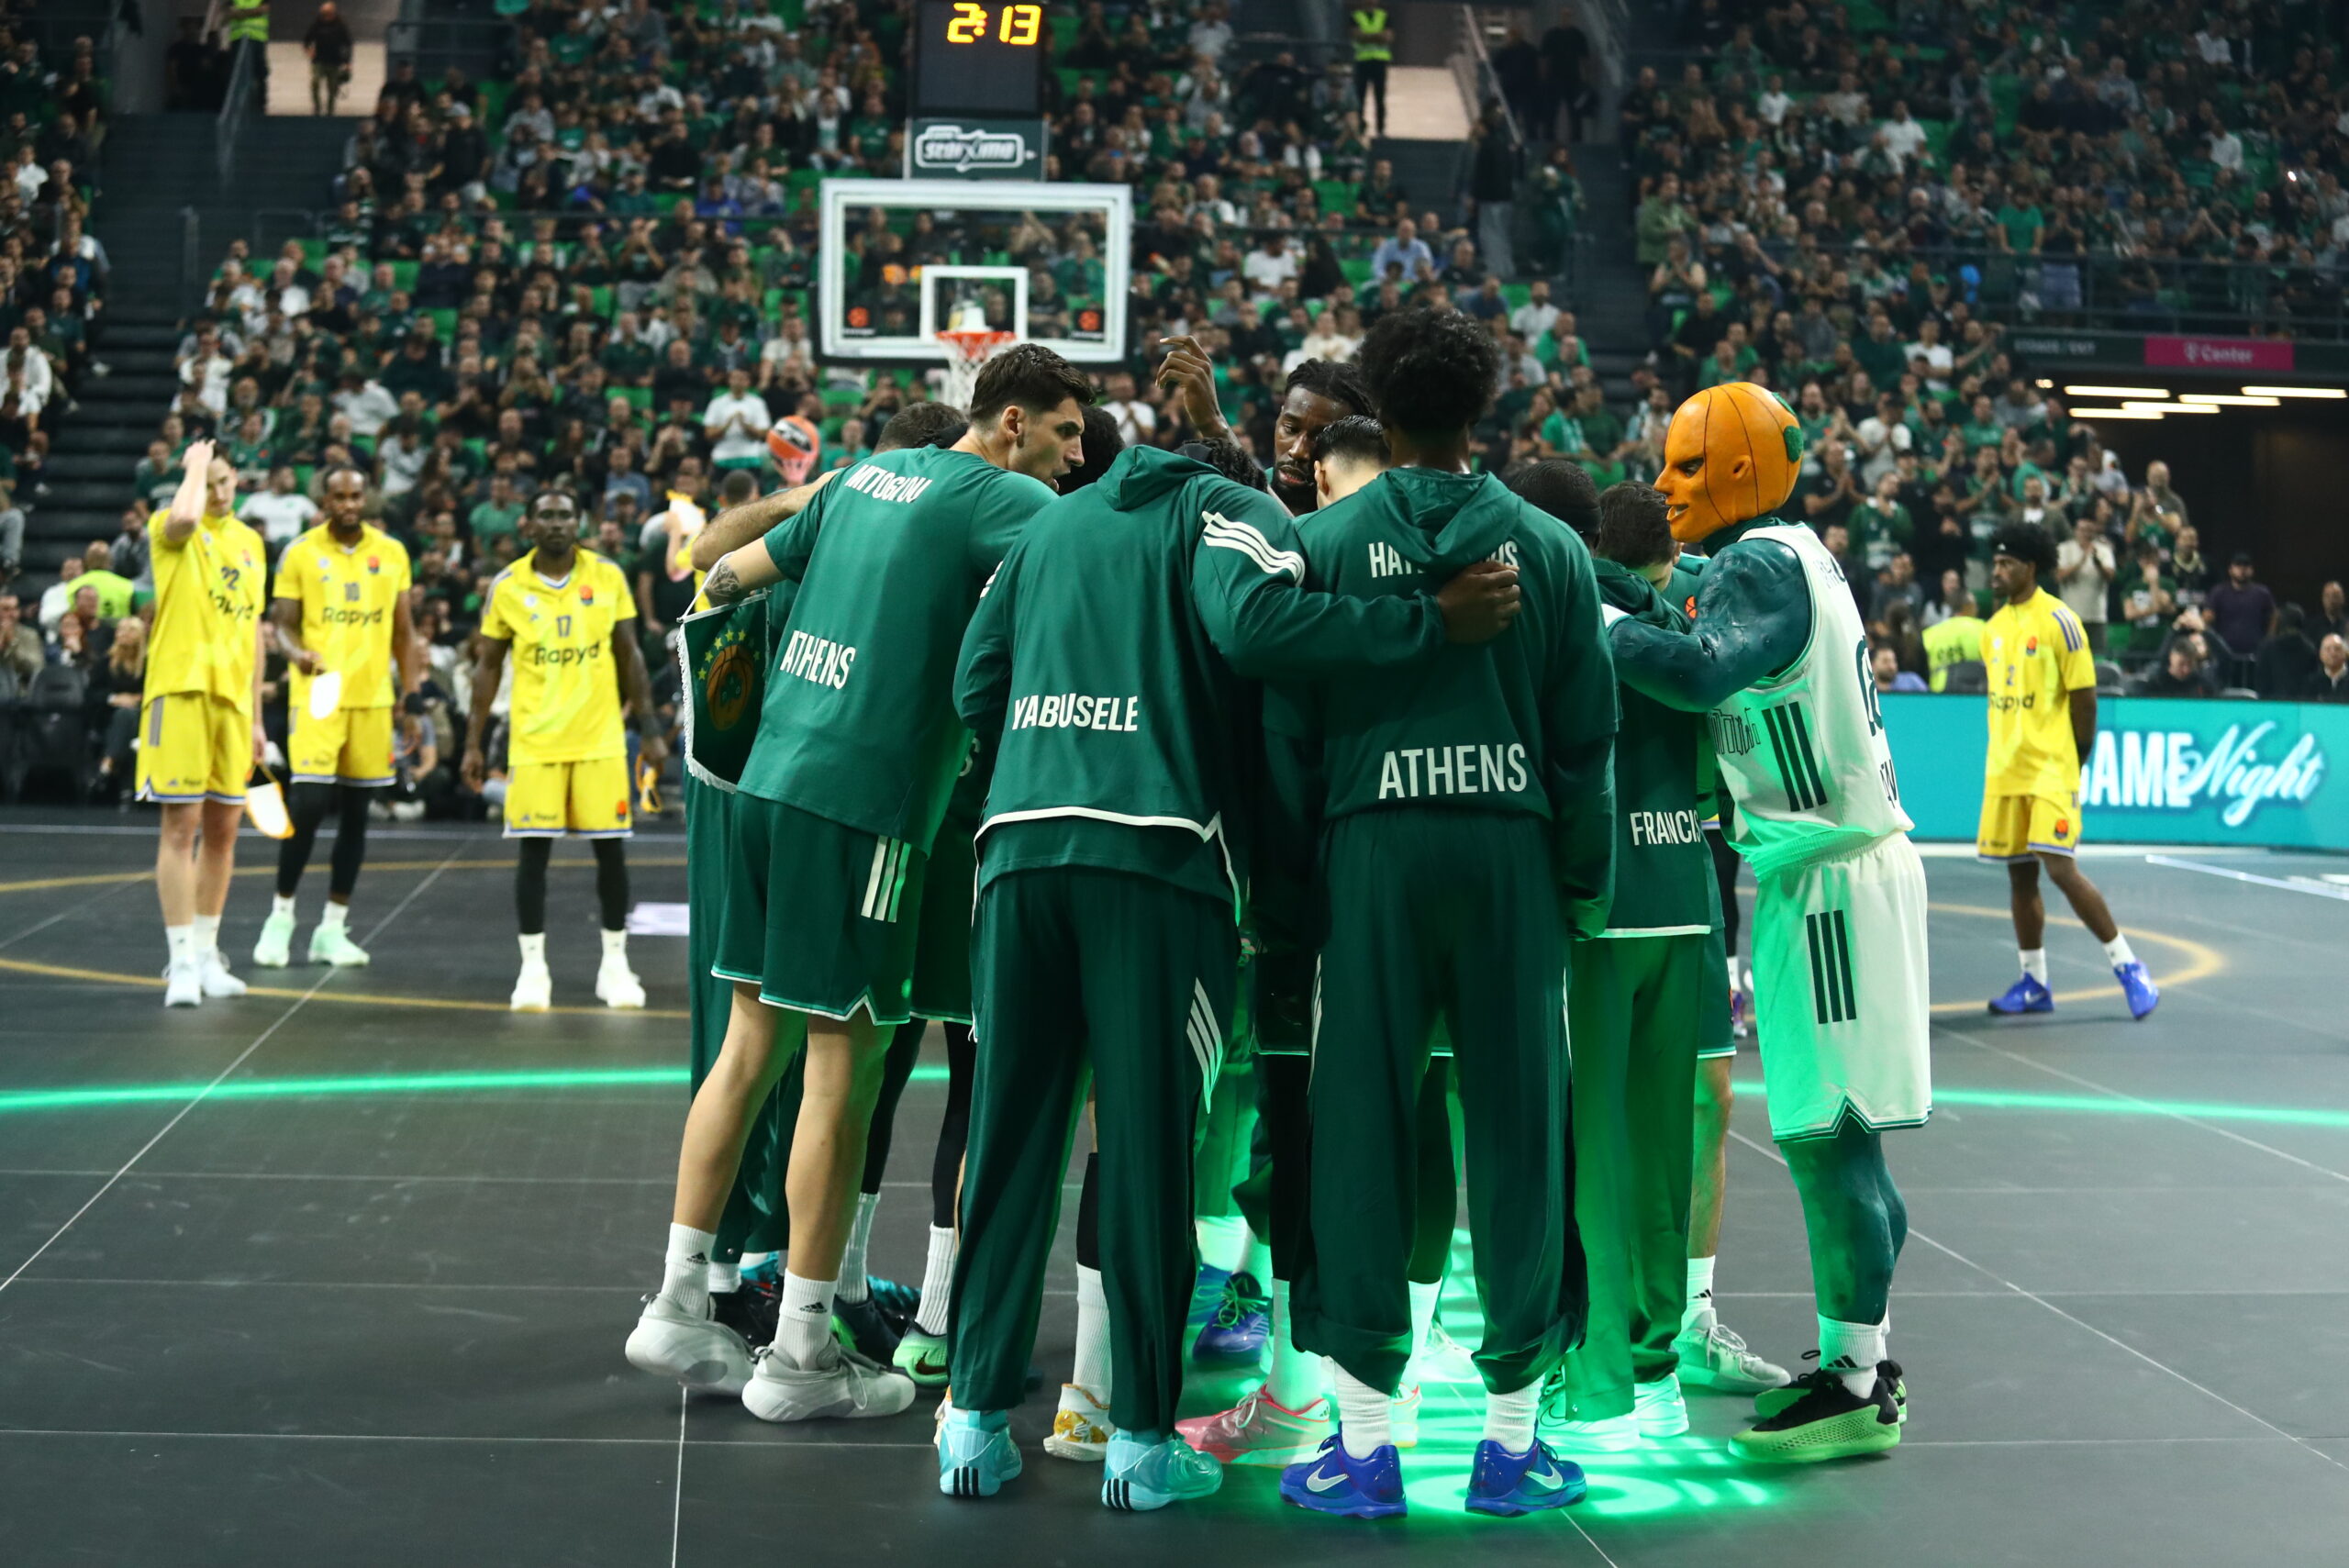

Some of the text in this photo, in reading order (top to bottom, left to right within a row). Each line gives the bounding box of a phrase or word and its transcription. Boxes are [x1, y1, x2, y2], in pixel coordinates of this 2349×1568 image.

[947, 3, 1041, 45] 2:13
[321, 606, 384, 628] Rapyd
[534, 639, 601, 668] Rapyd
[779, 629, 856, 691] ATHENS
[1011, 693, 1139, 732] YABUSELE
[1378, 743, 1528, 800] ATHENS
[2175, 719, 2324, 827] Night
[1630, 809, 1701, 846] FRANCIS
